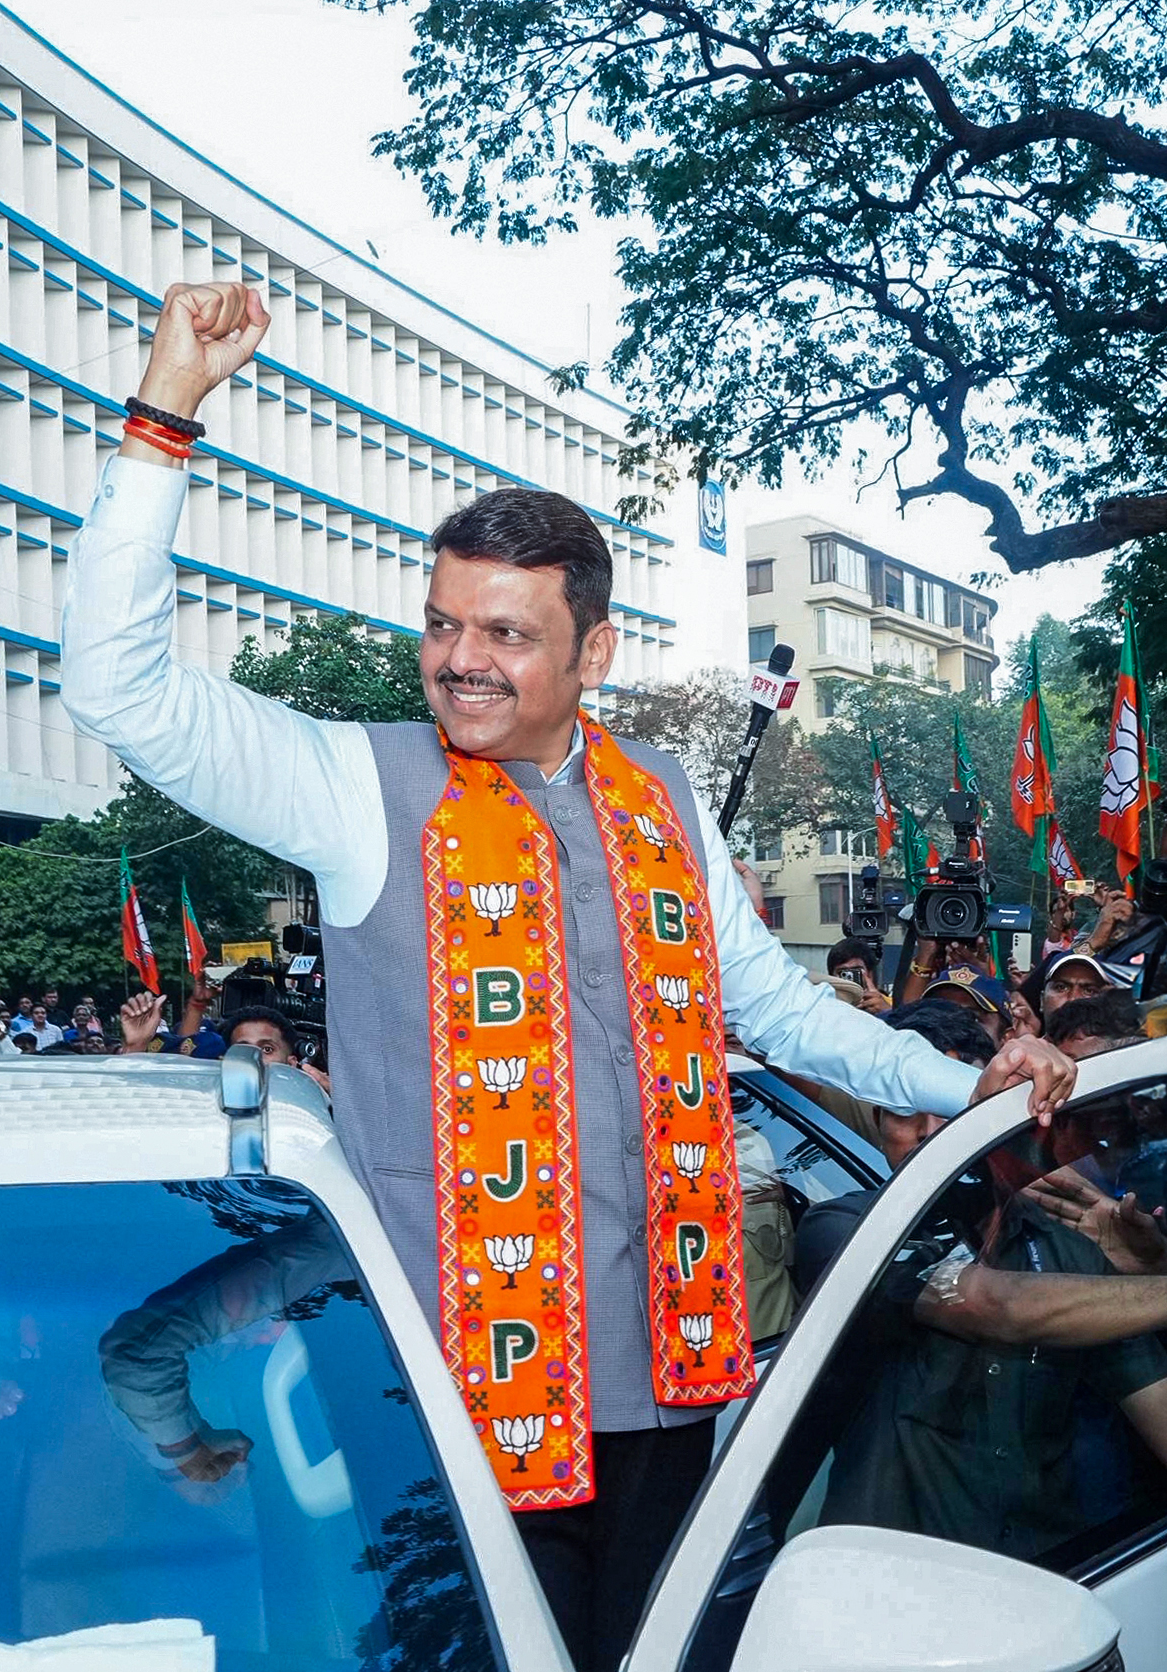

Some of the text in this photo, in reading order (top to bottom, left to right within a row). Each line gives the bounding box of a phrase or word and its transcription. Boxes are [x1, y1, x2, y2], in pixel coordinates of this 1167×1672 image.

[472, 966, 539, 1384] B J P
[650, 888, 709, 1282] B J P
